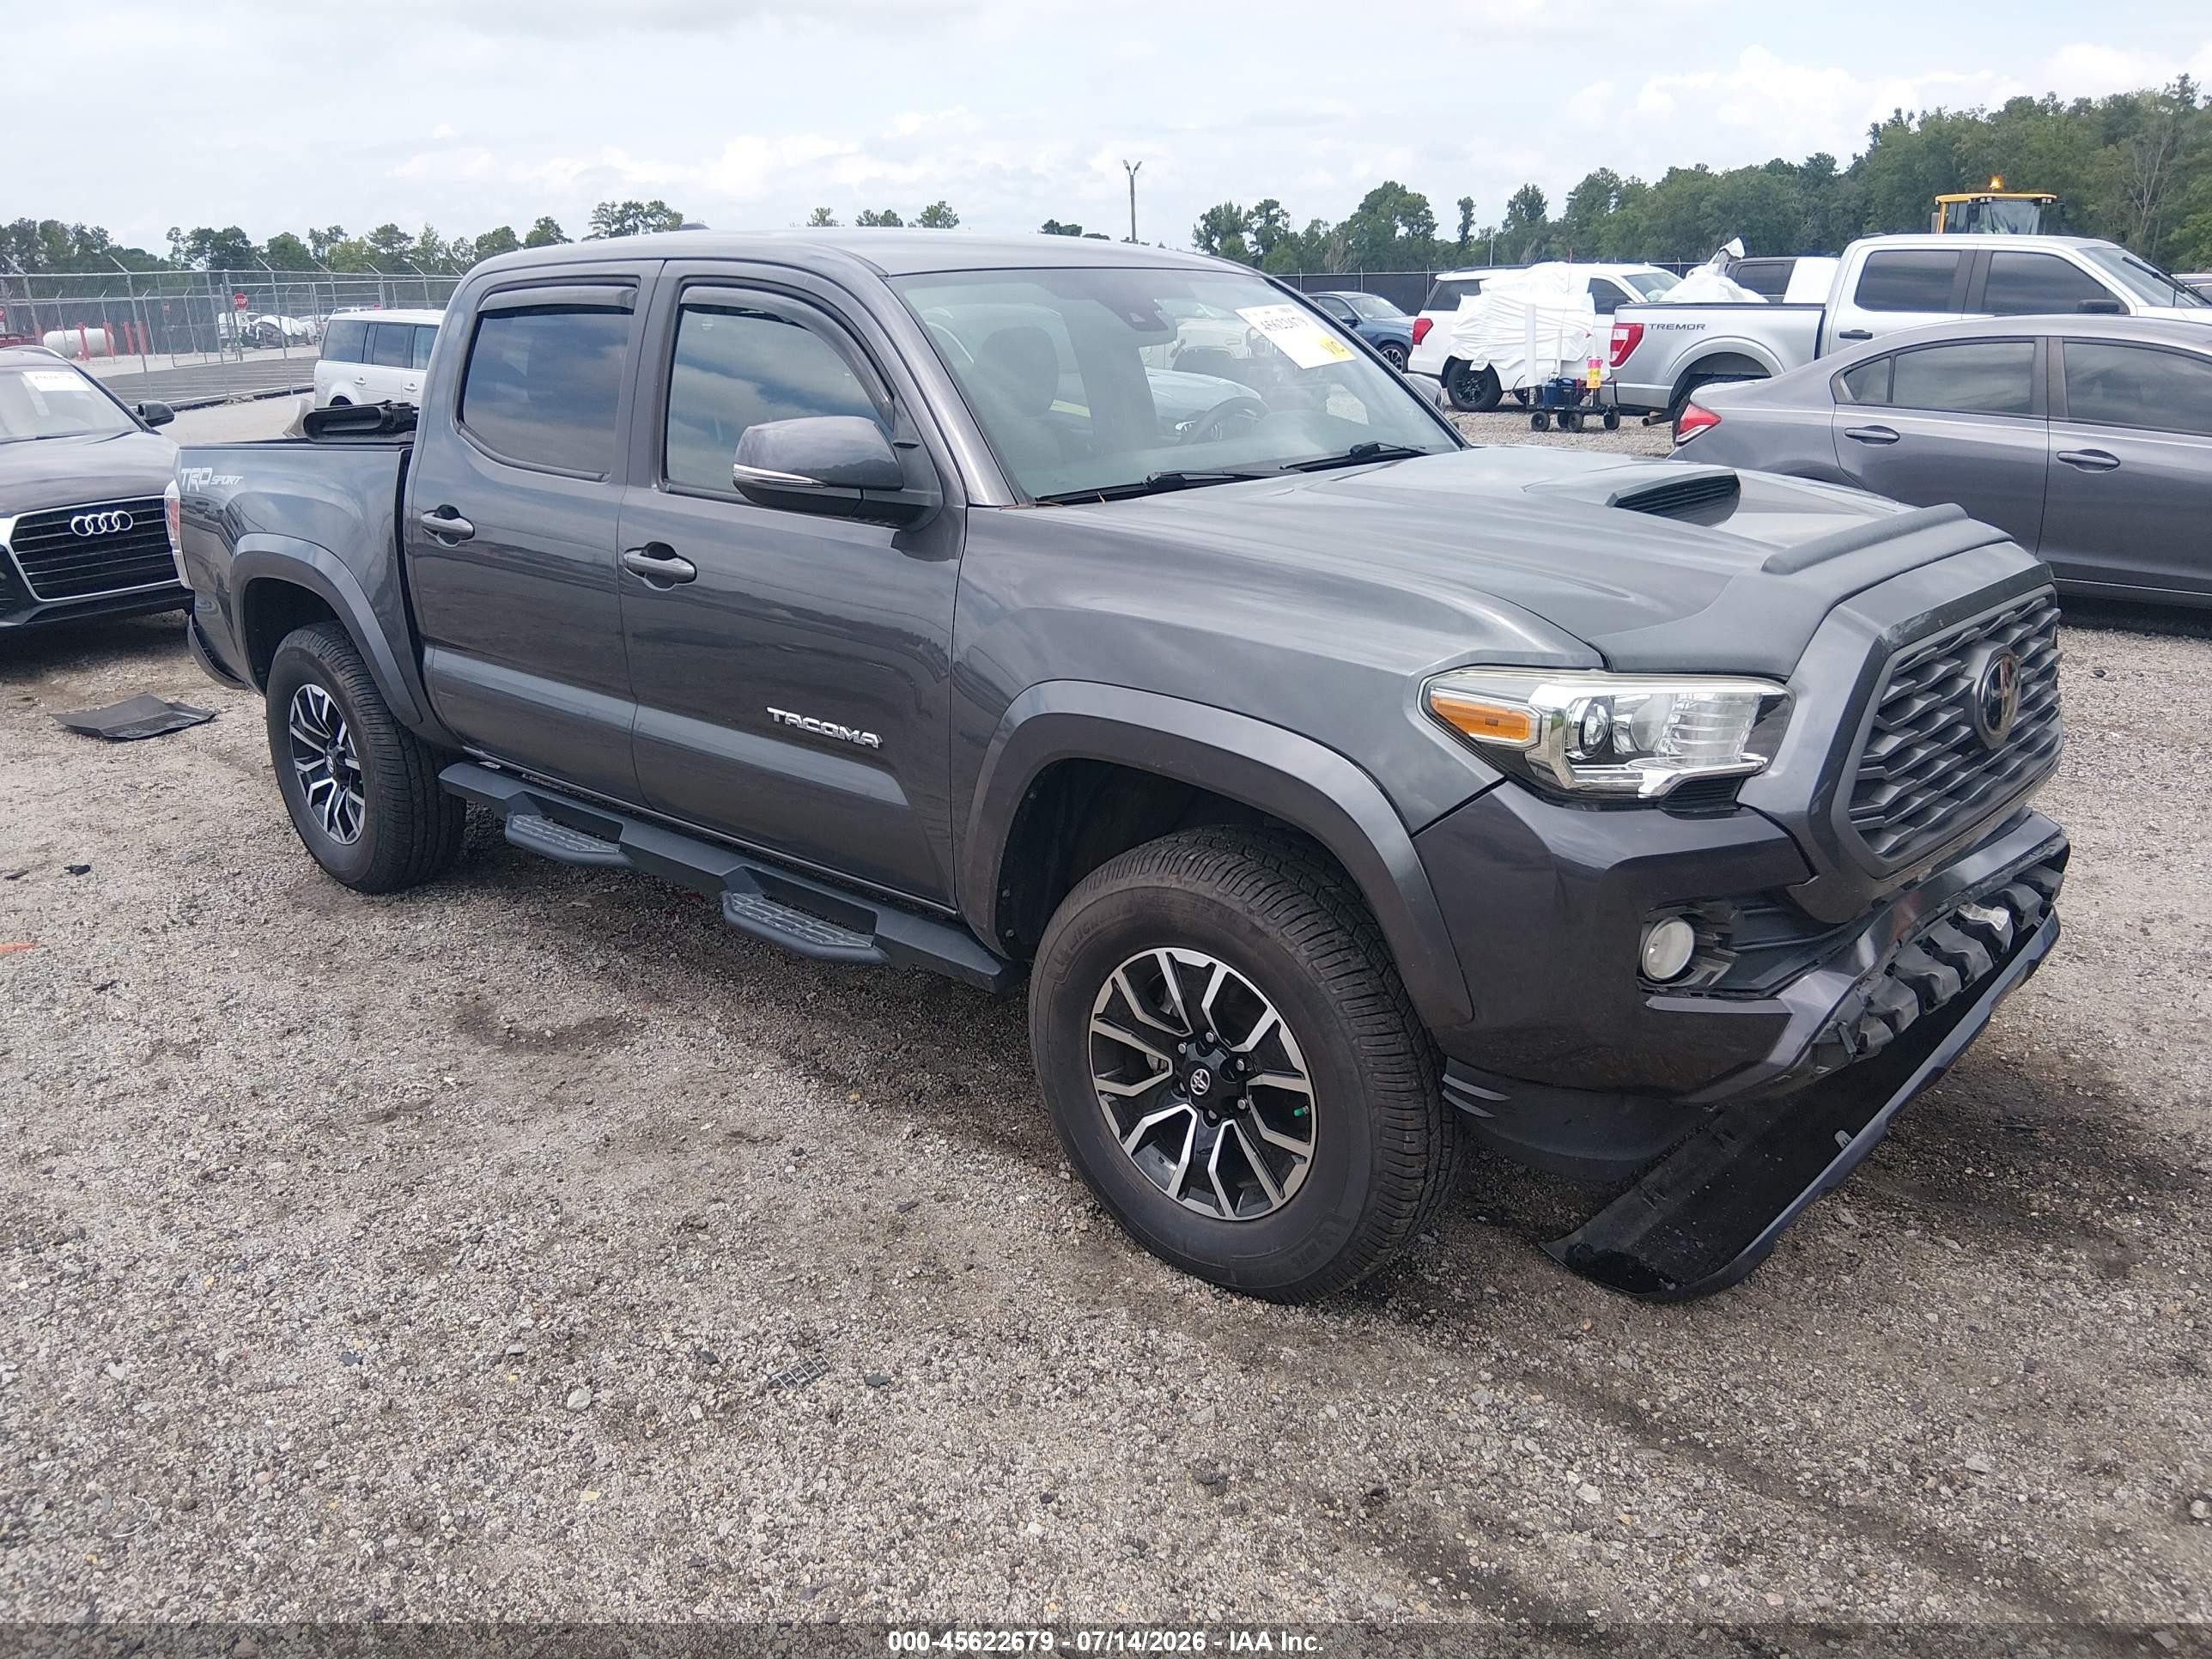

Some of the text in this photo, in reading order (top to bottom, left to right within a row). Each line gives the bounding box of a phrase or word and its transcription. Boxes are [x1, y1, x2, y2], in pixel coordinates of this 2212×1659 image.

[180, 467, 244, 492] TRD SPORT
[766, 707, 884, 750] TACOMA
